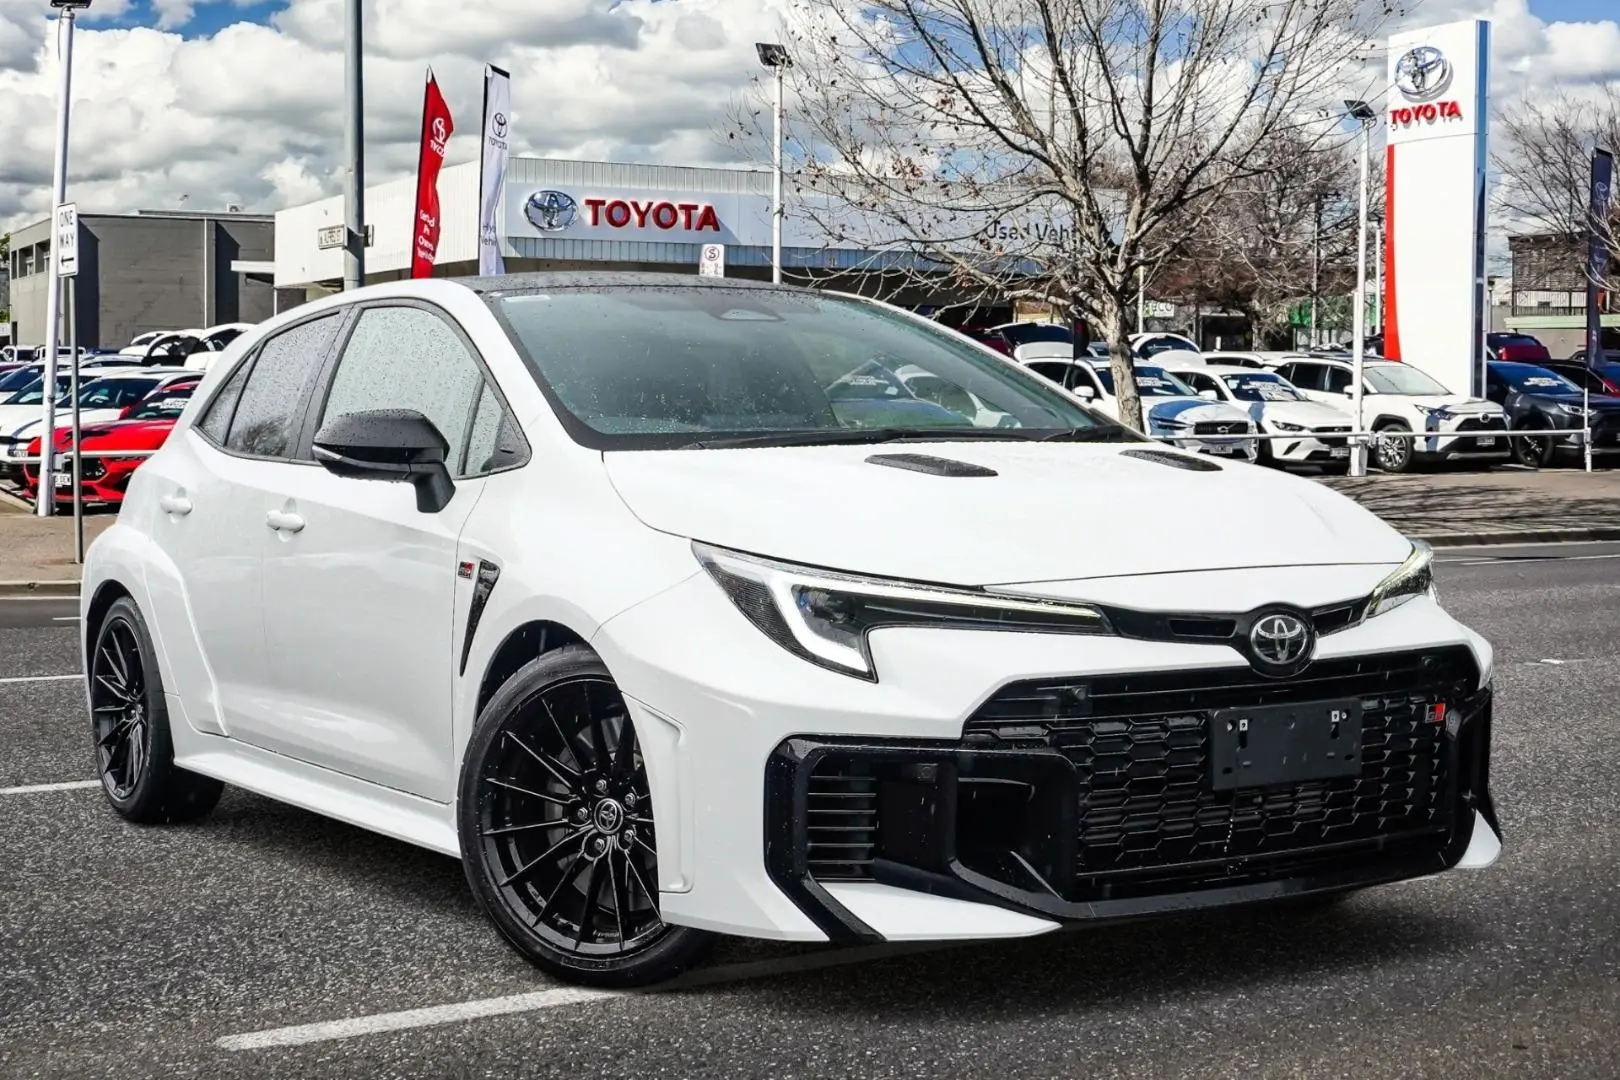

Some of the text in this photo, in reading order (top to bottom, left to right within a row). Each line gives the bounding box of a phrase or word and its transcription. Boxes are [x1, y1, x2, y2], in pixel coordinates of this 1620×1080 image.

[1390, 101, 1462, 124] TOYOTA
[60, 210, 73, 227] ONE
[584, 198, 720, 231] TOYOTA
[986, 220, 1030, 239] Used
[60, 232, 73, 248] WAY
